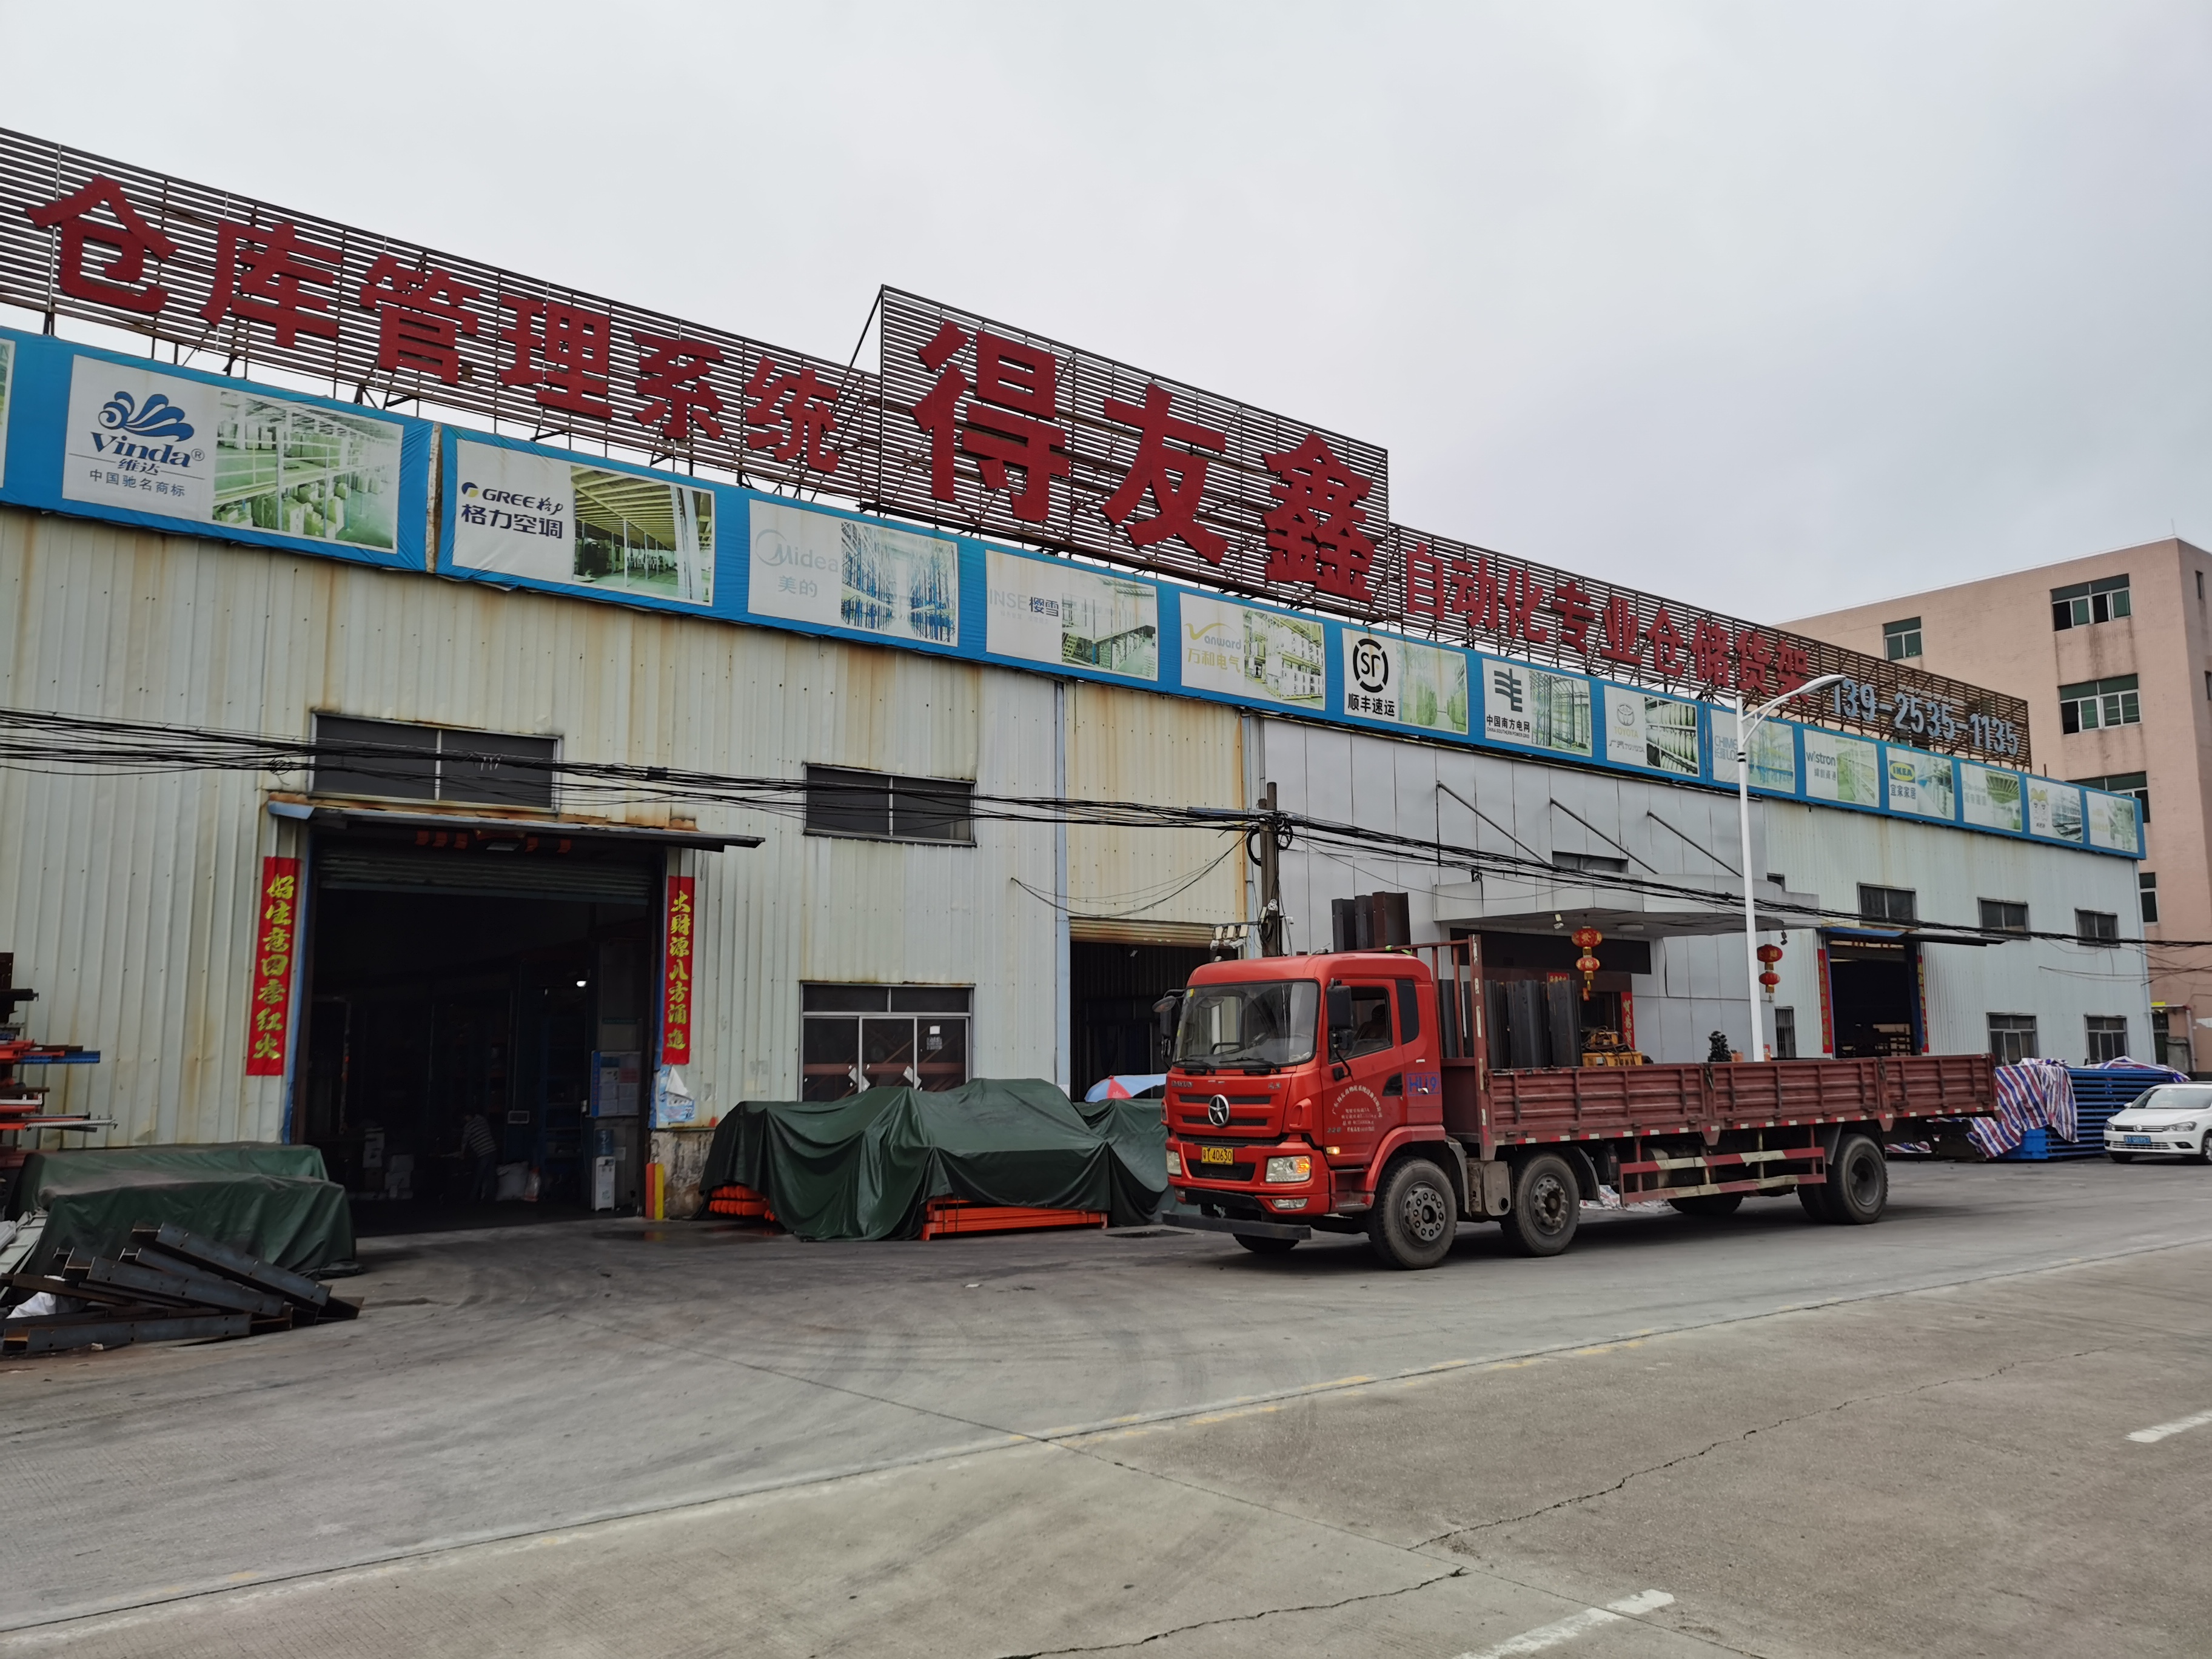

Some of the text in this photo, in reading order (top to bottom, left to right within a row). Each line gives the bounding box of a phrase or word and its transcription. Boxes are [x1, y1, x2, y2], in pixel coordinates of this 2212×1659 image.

[25, 173, 839, 473] 仓库管理系统
[90, 431, 191, 468] Vinda
[910, 321, 1376, 603] 得友鑫
[118, 458, 161, 476] 维达
[90, 469, 186, 497] 中国驰名商标
[482, 488, 536, 509] GREE
[461, 504, 563, 539] 格力空调
[765, 541, 838, 572] Midea
[778, 575, 817, 598] 美的
[990, 588, 1059, 617] INSE 樱雪
[1406, 542, 1809, 704] 自动化专业仓储货架
[1187, 648, 1241, 673] 万和电气
[1348, 693, 1395, 717] 顺丰速运
[1487, 714, 1530, 732] 中国南方电网
[1614, 726, 1638, 738] TOYOTA
[1892, 766, 1912, 777] IKEA
[1891, 784, 1916, 800] 宜家家居
